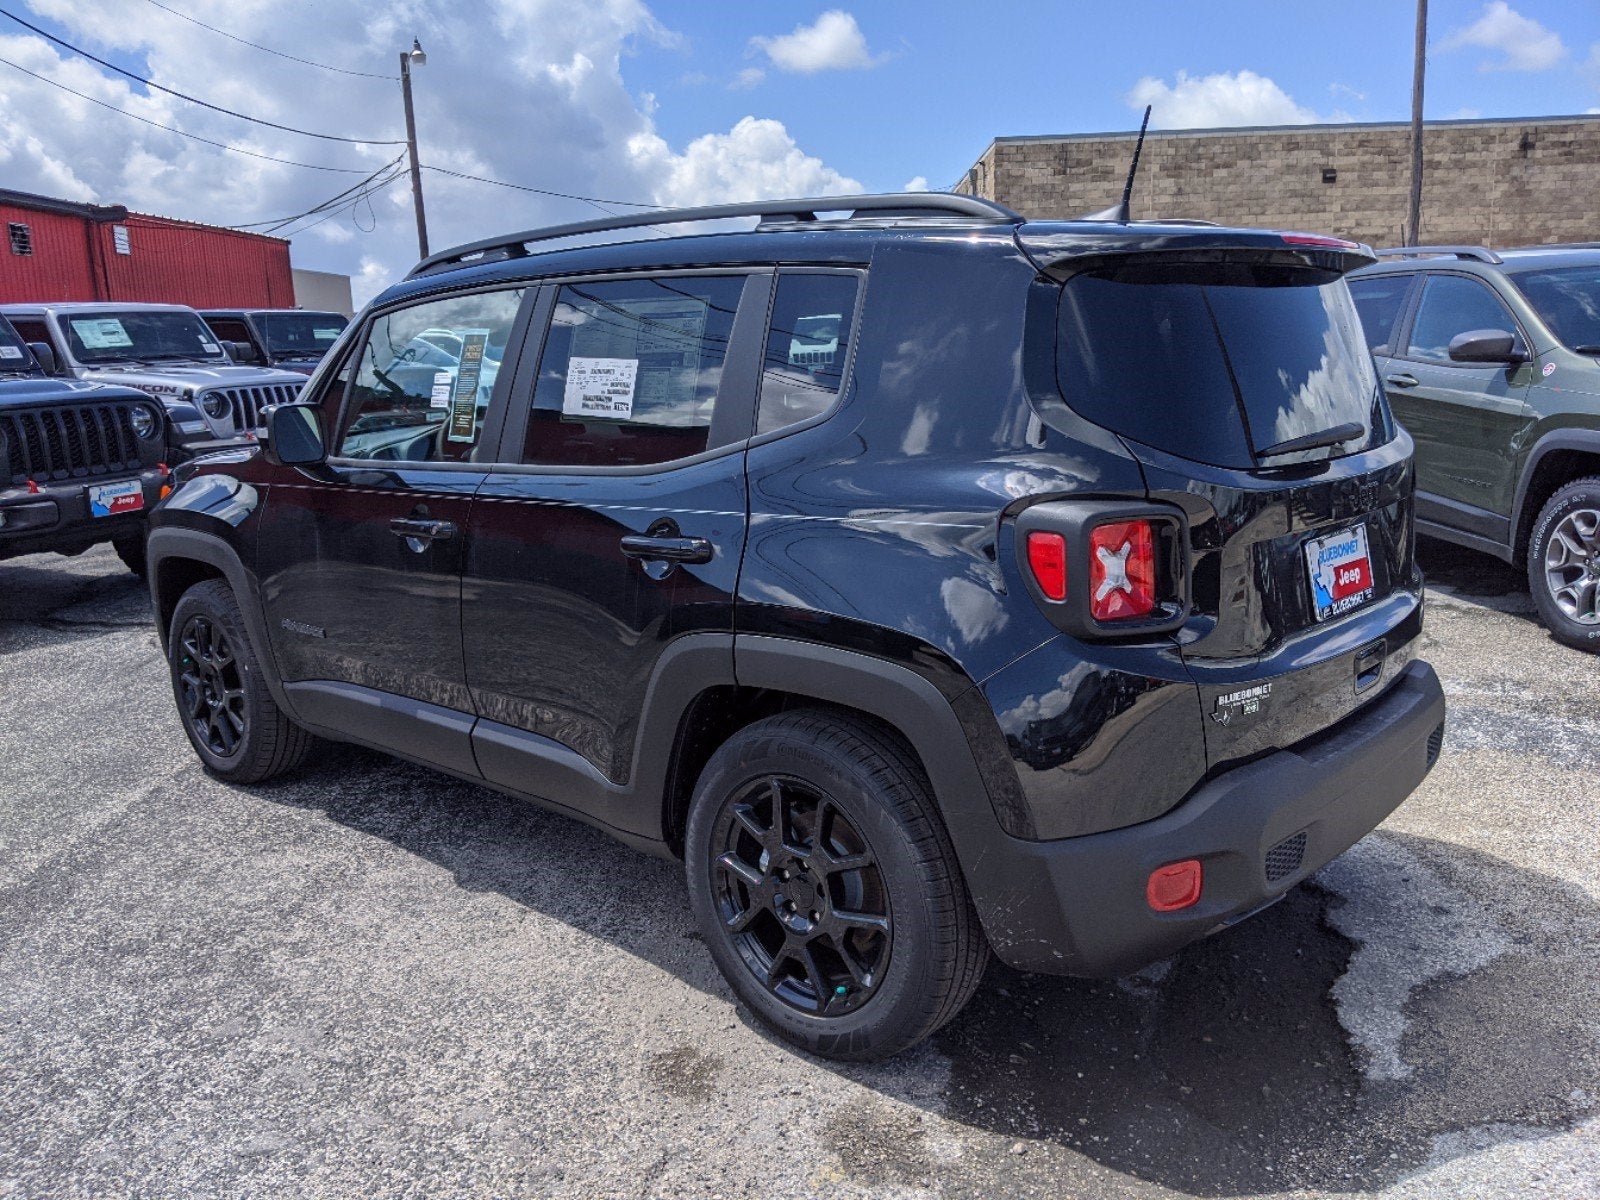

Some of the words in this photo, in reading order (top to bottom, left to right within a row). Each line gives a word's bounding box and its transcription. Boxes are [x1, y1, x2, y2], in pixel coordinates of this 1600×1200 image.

[117, 496, 136, 505] Jeep
[1318, 539, 1358, 564] BLUEBONNET
[1338, 567, 1361, 587] Jeep
[1218, 682, 1272, 706] BLUEBONNET
